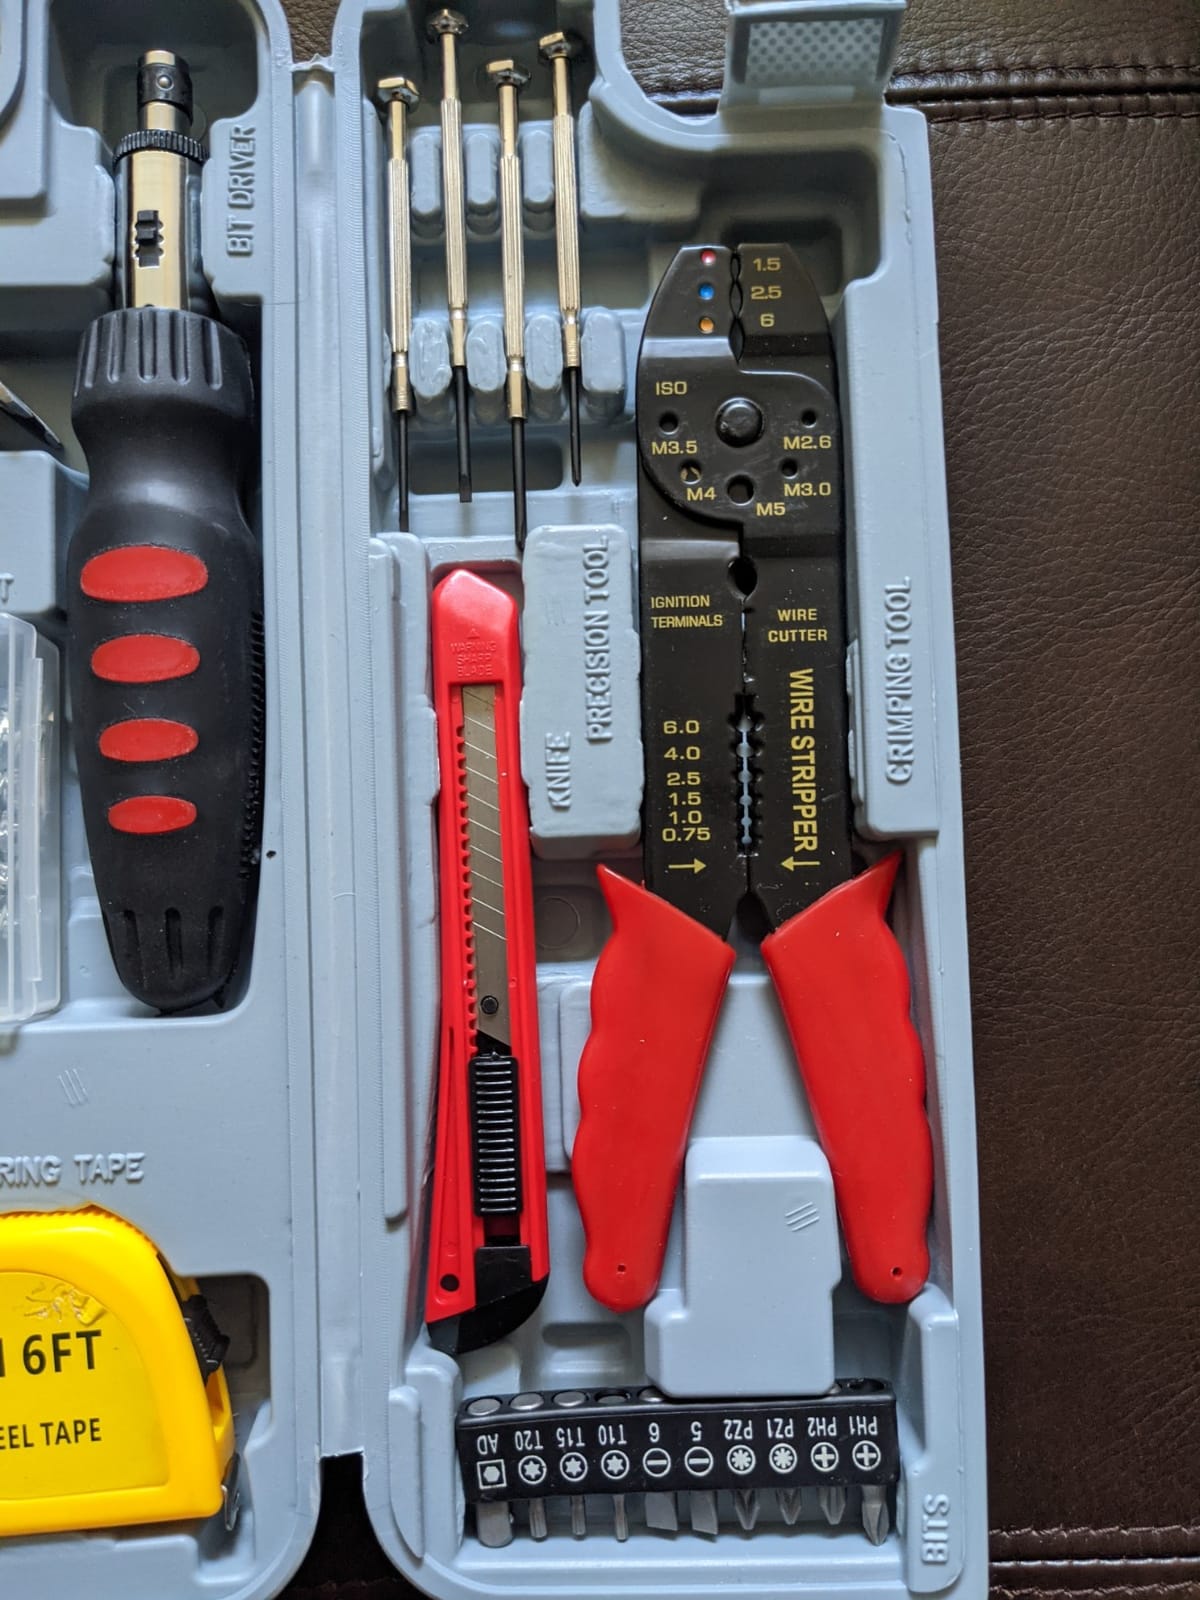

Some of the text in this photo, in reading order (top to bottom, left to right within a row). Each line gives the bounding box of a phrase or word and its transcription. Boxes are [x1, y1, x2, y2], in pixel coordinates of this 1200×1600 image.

[226, 125, 256, 258] BIT DRIVER
[753, 257, 781, 271] 1.5
[751, 286, 782, 300] 2.5
[759, 313, 775, 327] 6
[655, 381, 688, 395] ISO
[651, 440, 698, 455] M3.5
[783, 435, 832, 450] M2.6
[686, 487, 716, 501] M4
[783, 482, 832, 497] M3.0
[756, 502, 786, 516] M5
[650, 595, 711, 609] IGNITION
[650, 614, 723, 629] TERMINALS
[777, 608, 818, 622] WIRE
[583, 535, 613, 743] PRECISION TOOL
[767, 628, 828, 643] CUTTER
[884, 575, 914, 784] CRIMPING TOOL
[663, 720, 700, 734] 6.0
[664, 746, 701, 760] 4.0
[789, 668, 819, 852] WIRE STRIPPER
[545, 731, 572, 811] KNIFE
[666, 772, 701, 786] 2.5
[668, 792, 701, 806] 1.5
[668, 811, 702, 824] 1.0
[662, 827, 711, 841] 0.75
[73, 1152, 145, 1185] TAPE
[22, 1329, 102, 1376] 6FT
[39, 1417, 102, 1446] TAPE
[476, 1415, 878, 1455] PH1 PH2 PZ1 PZ2 5 6 T10 T15 T20 AD
[922, 1493, 951, 1564] BITS
